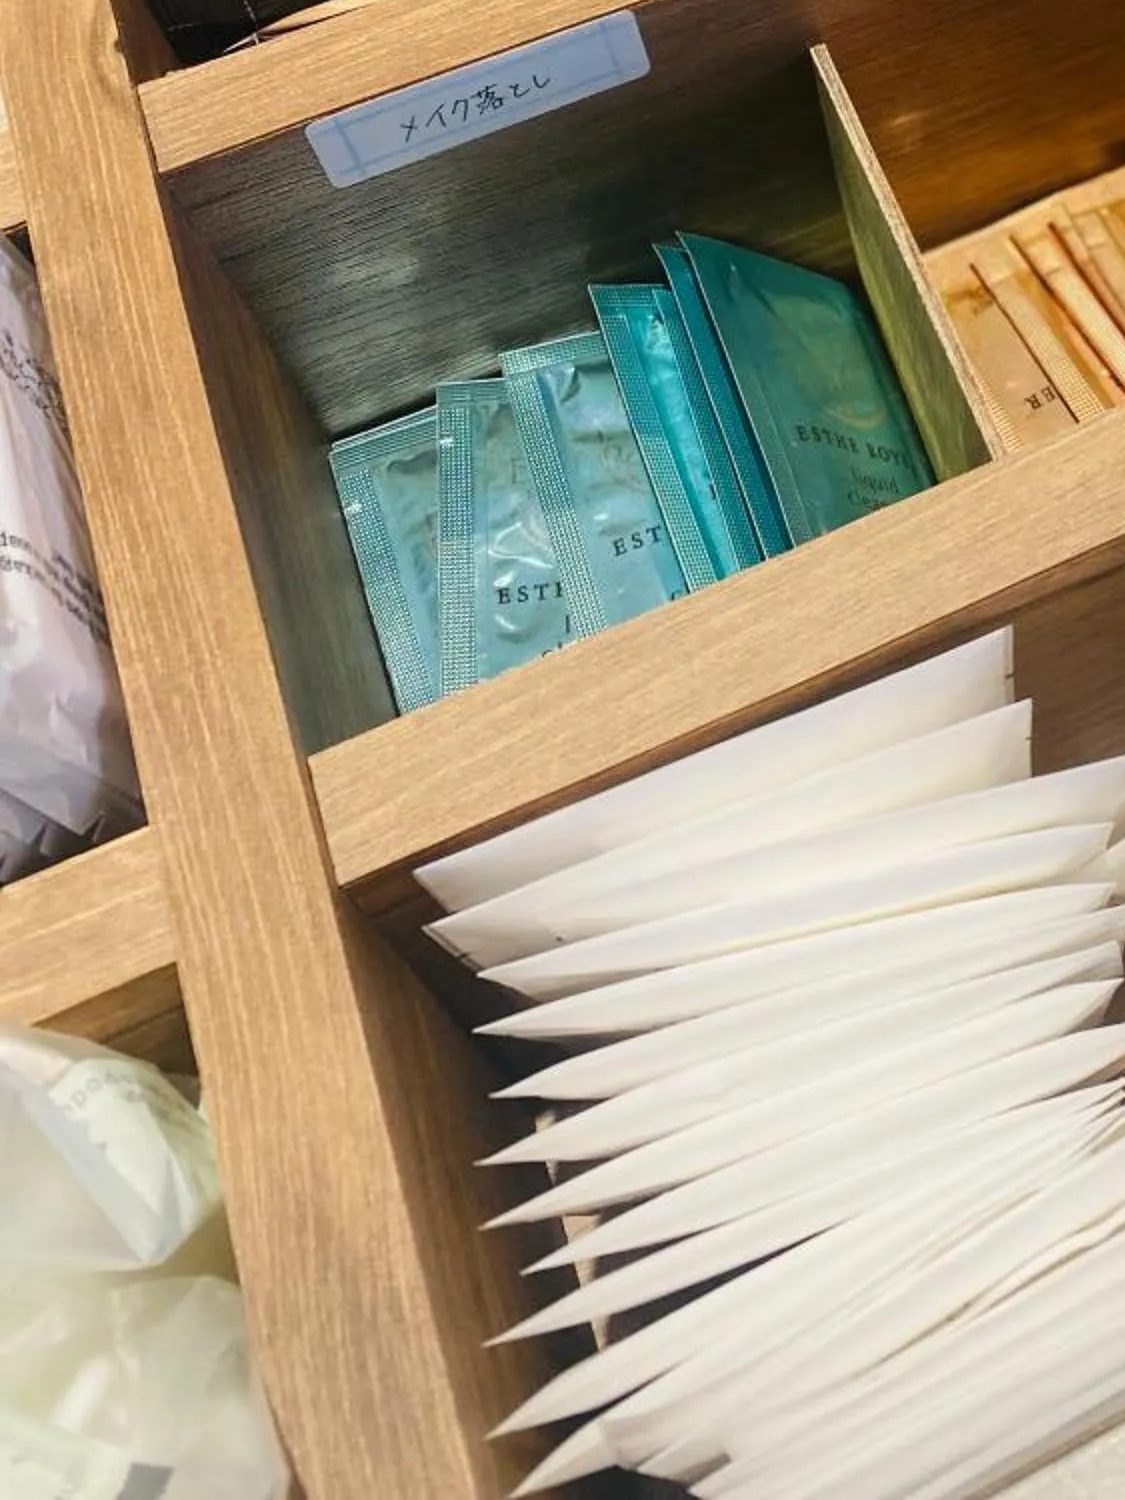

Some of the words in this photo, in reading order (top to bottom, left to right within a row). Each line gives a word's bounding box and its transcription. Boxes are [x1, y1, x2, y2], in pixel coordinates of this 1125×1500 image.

[400, 75, 550, 142] メイク落とし
